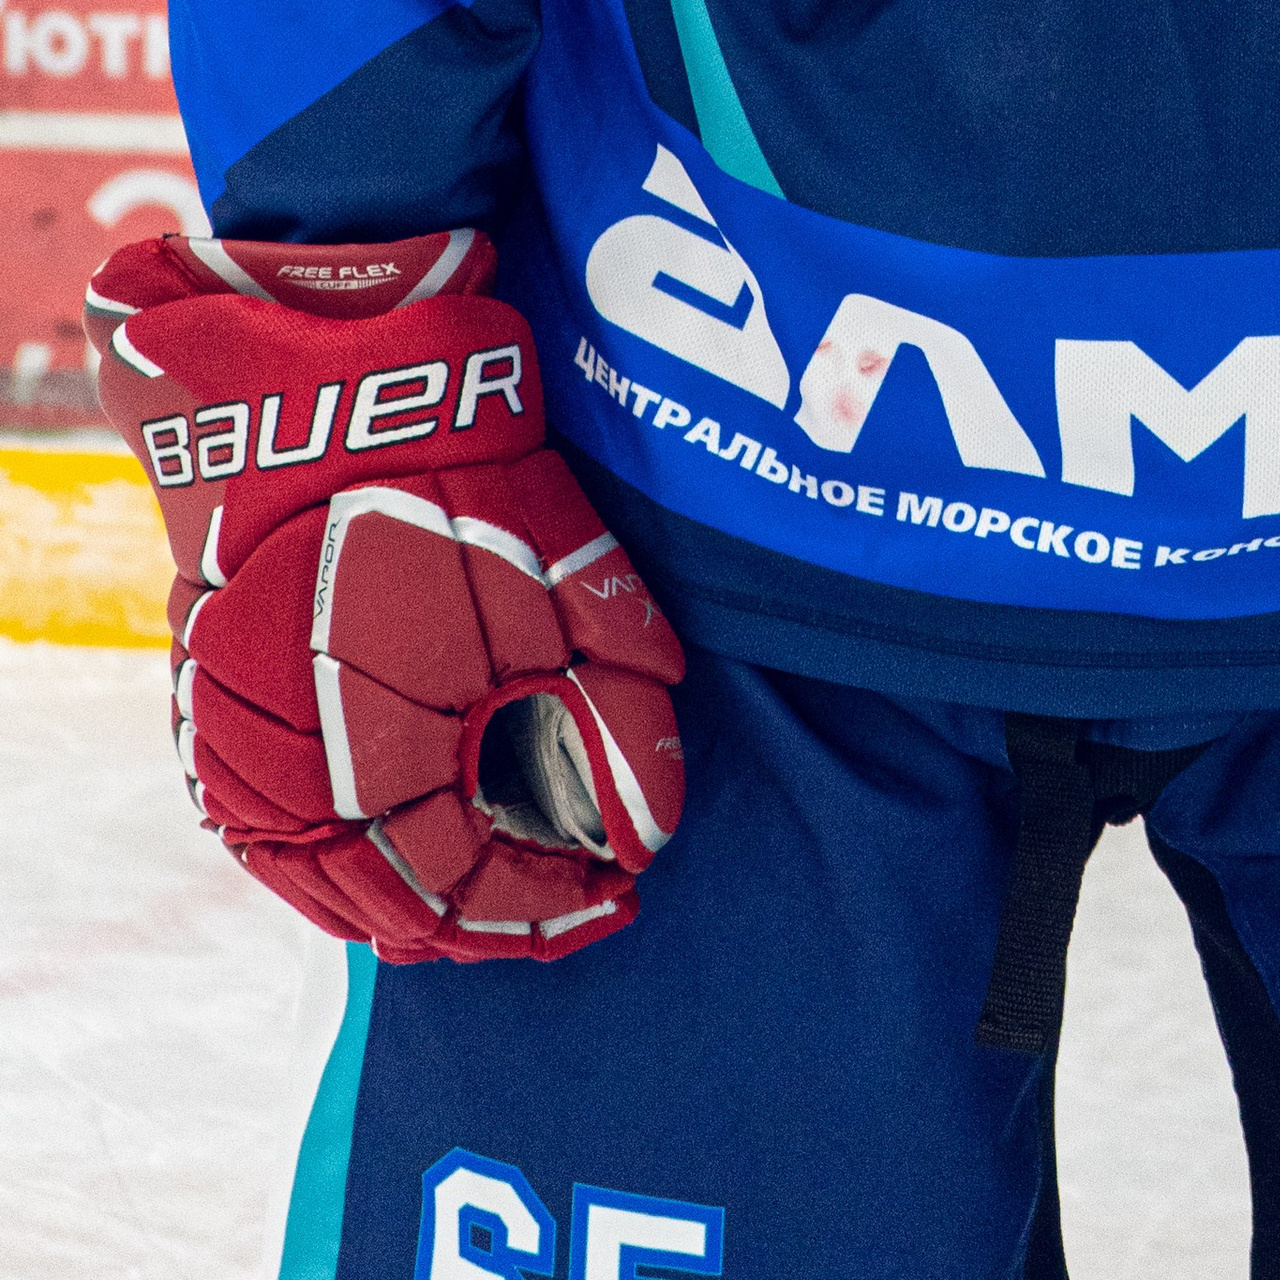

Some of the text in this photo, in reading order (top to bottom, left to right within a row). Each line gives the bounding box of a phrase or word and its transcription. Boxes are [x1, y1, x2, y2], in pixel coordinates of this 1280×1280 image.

[276, 262, 401, 278] FREE FLEX
[573, 337, 886, 517] ЦЕНТРАЛЬНОЕ
[896, 491, 1143, 570] МОРСКОЕ
[313, 517, 343, 620] VAPOR
